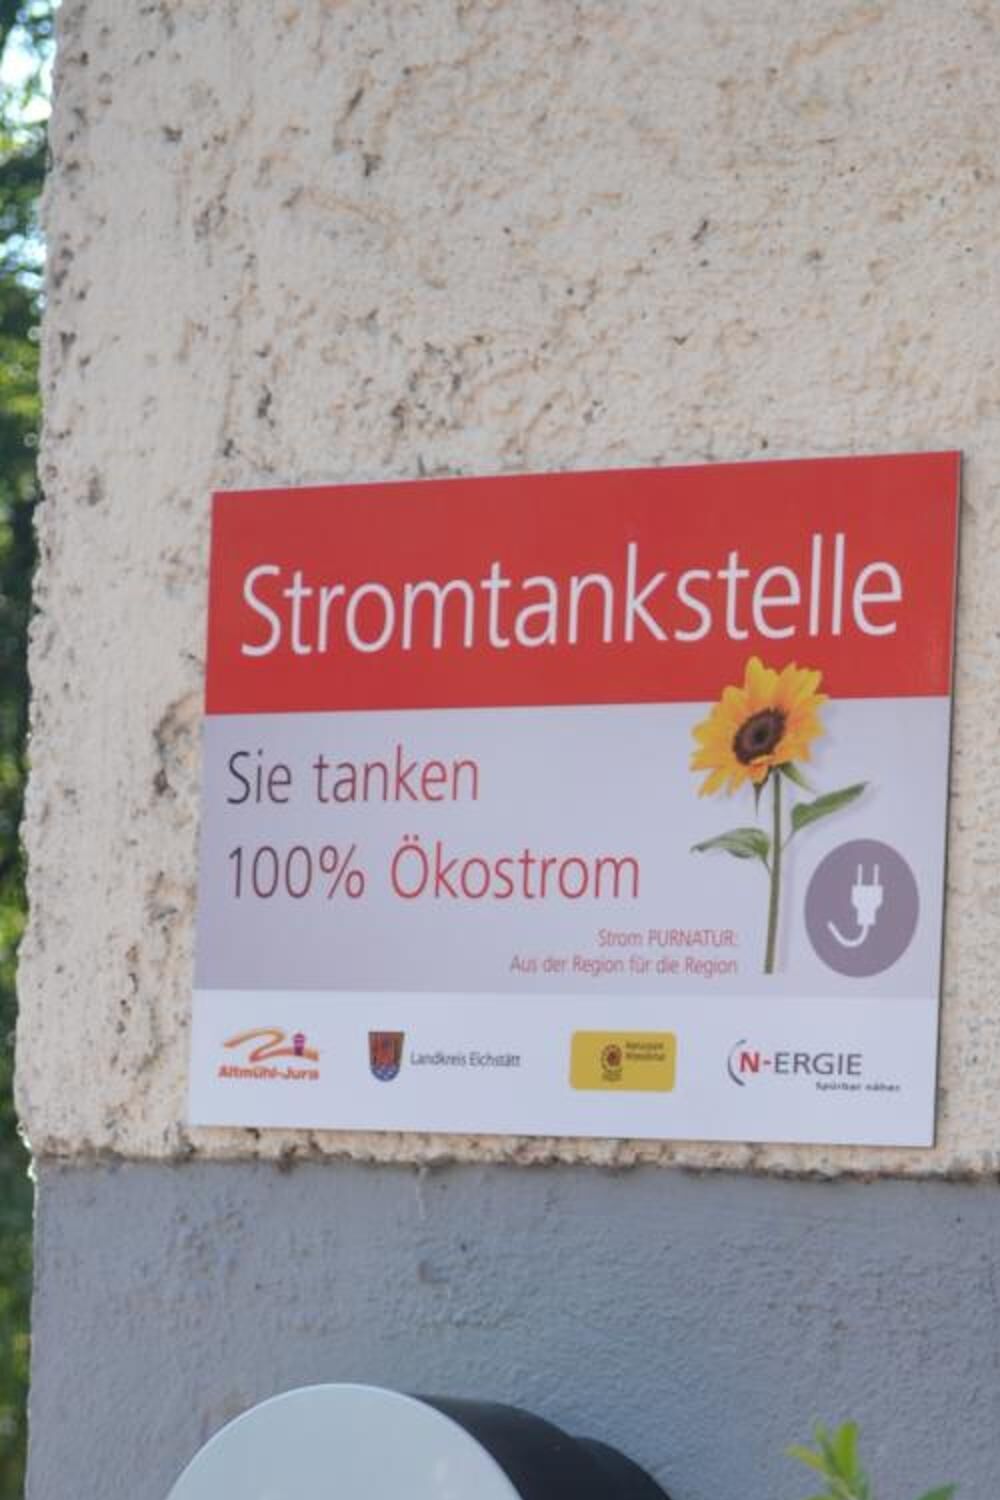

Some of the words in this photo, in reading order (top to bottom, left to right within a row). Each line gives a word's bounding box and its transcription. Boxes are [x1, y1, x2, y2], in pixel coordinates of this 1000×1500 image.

[241, 533, 902, 657] Stromtankstelle
[227, 749, 292, 804] Sie
[312, 744, 480, 803] tanken
[228, 844, 366, 899] 100%
[391, 834, 641, 899] Ökostrom
[599, 929, 642, 947] Strom
[510, 955, 538, 973] Aus
[543, 955, 566, 973] der
[573, 956, 624, 977] Region
[630, 955, 652, 974] für
[656, 956, 680, 974] die
[684, 956, 738, 978] Region
[409, 1051, 466, 1067] Landkreis
[739, 1051, 863, 1076] N-ERGIE
